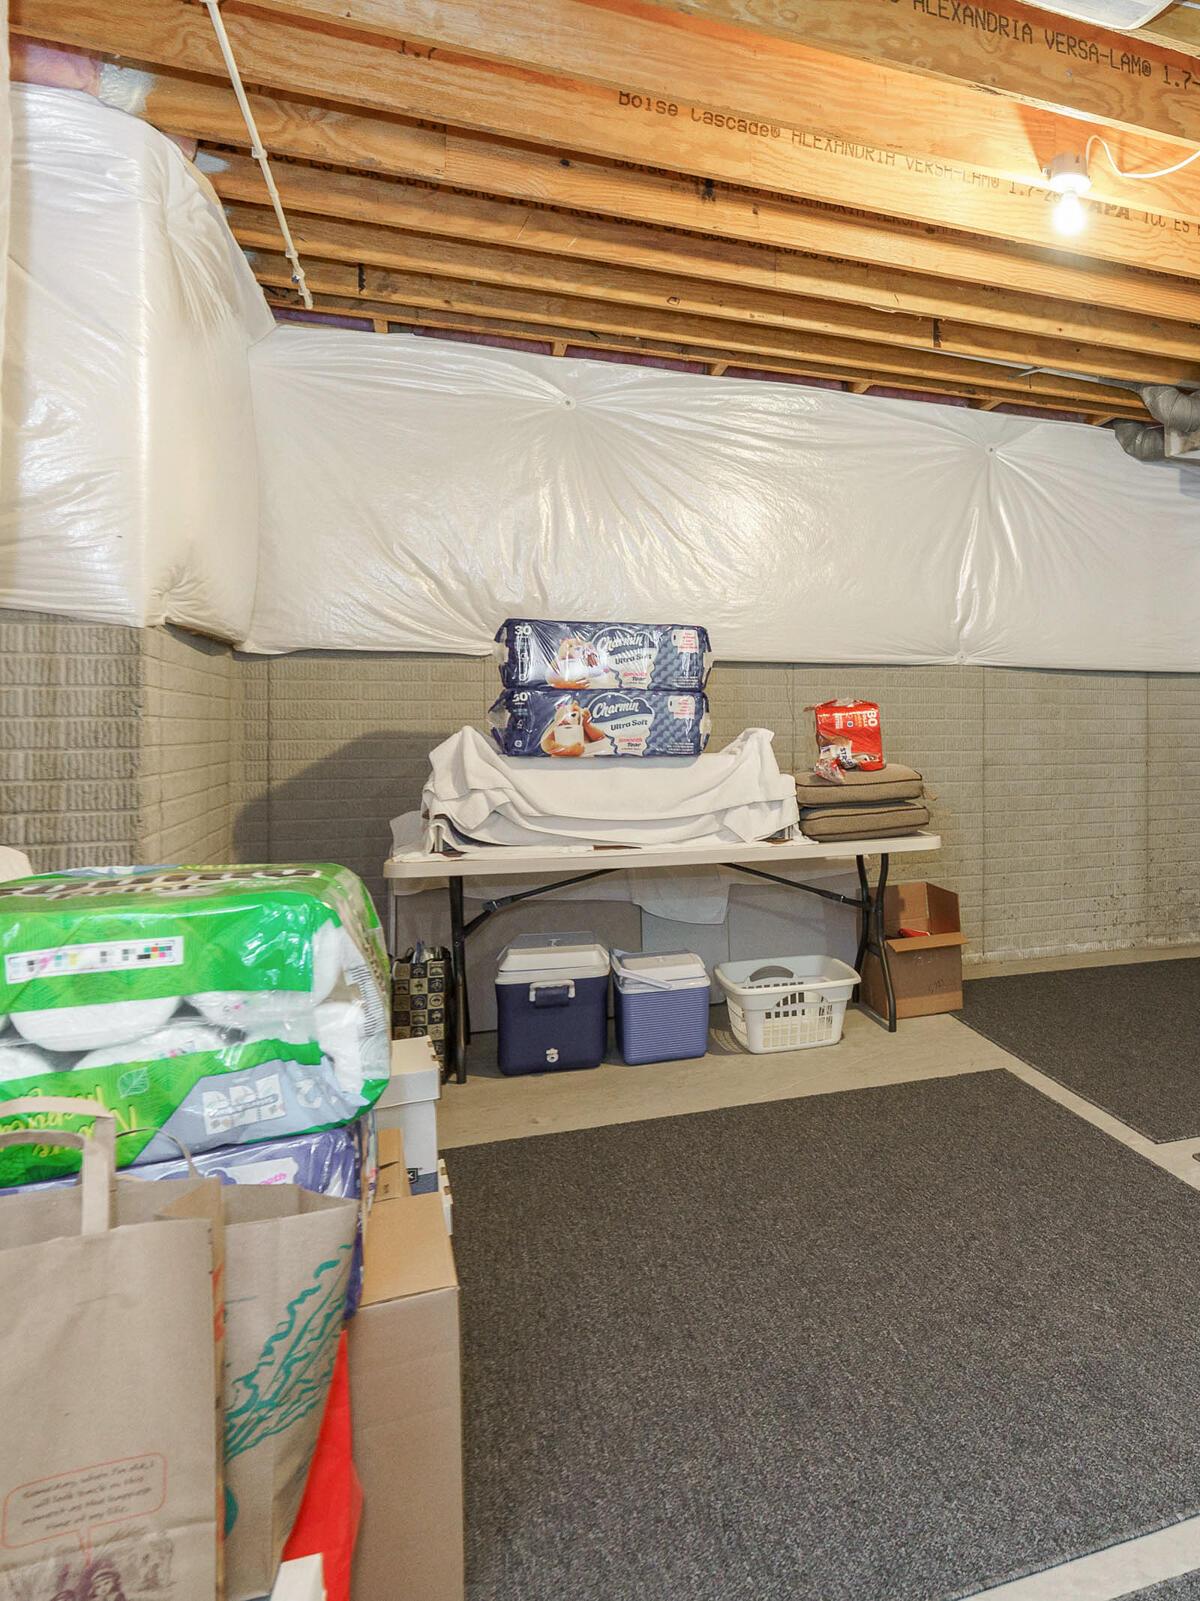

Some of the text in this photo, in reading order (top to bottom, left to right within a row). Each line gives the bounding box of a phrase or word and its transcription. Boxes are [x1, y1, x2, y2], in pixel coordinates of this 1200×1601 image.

[914, 0, 1032, 44] ALEXANDRIA
[592, 701, 640, 718] Charmin
[611, 719, 648, 731] Ultra Soft
